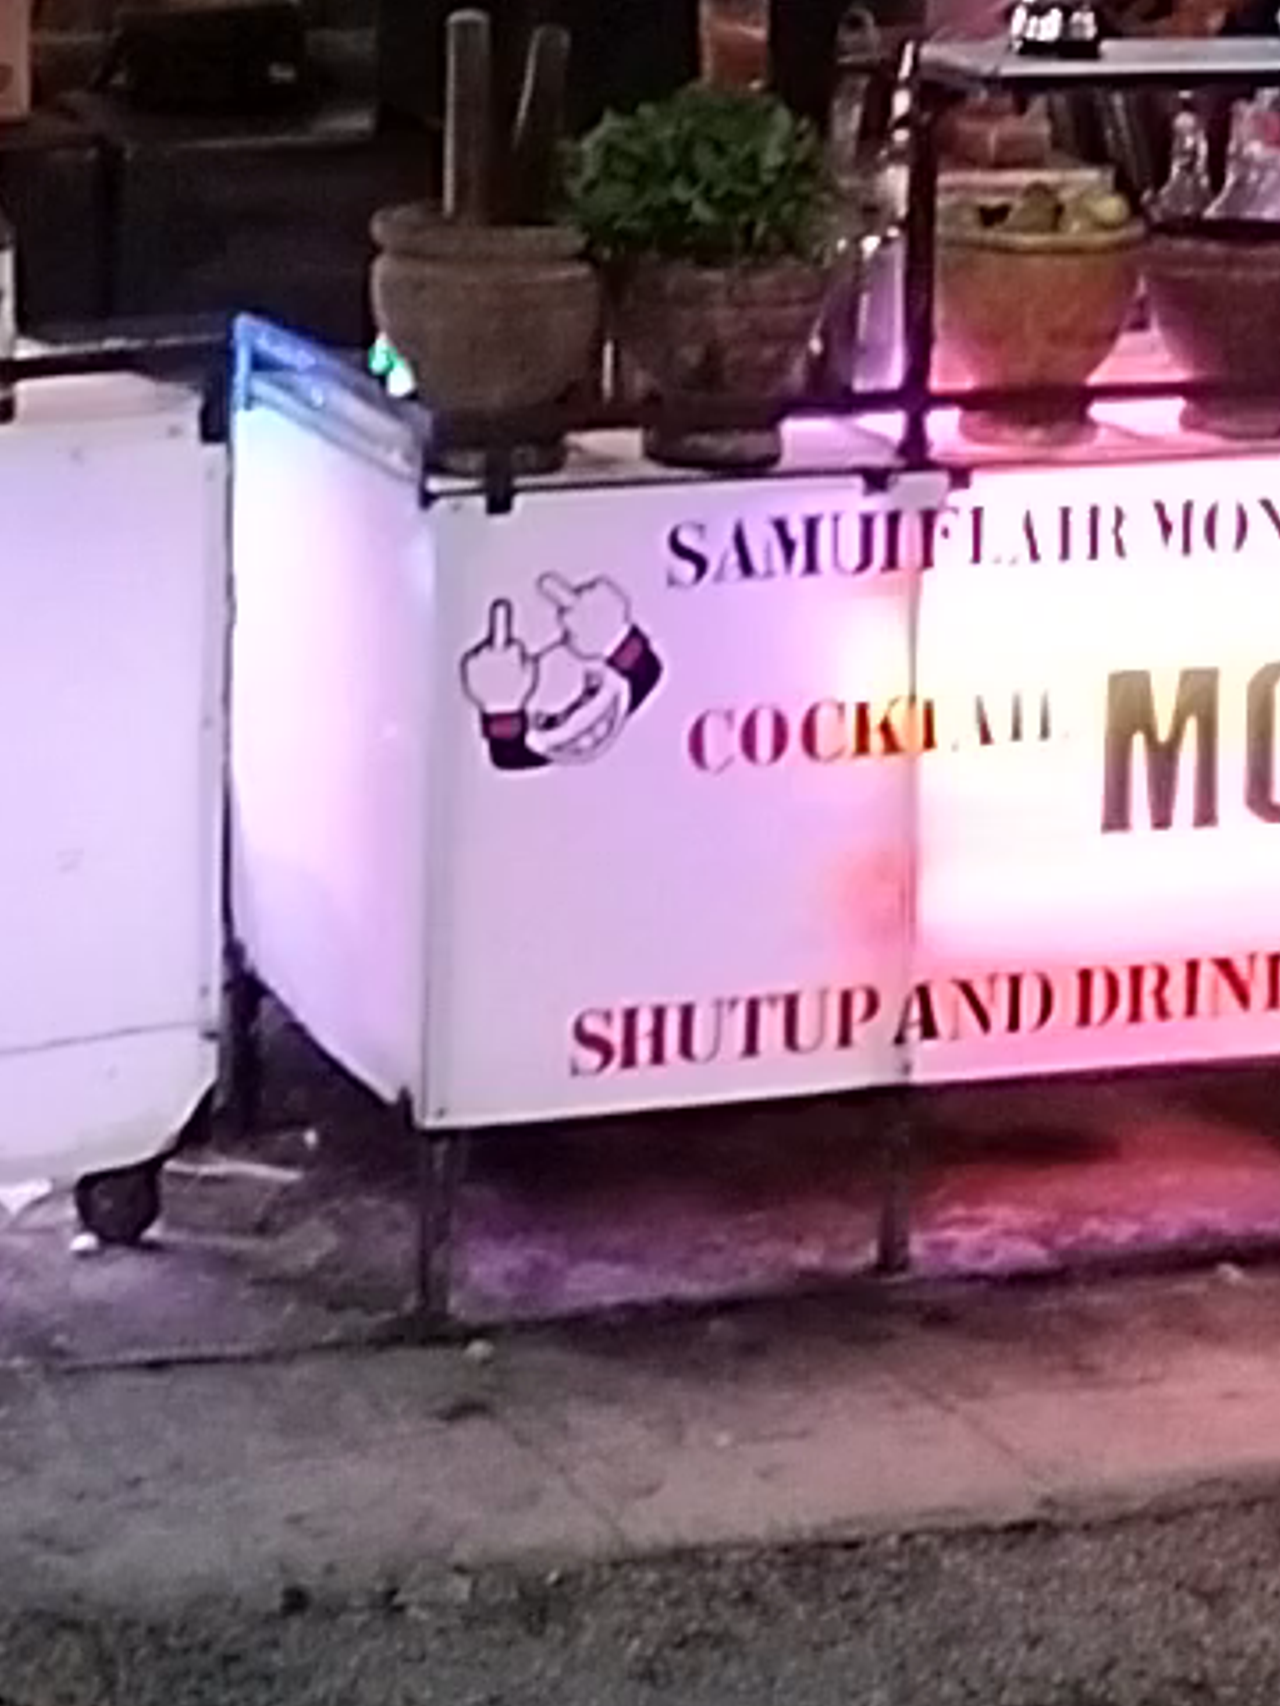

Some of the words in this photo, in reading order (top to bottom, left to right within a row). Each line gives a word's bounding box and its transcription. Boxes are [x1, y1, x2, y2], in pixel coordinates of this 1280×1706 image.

[666, 509, 904, 588] SAMUI
[687, 689, 1072, 774] COCKTAIL
[894, 971, 1056, 1046] AND
